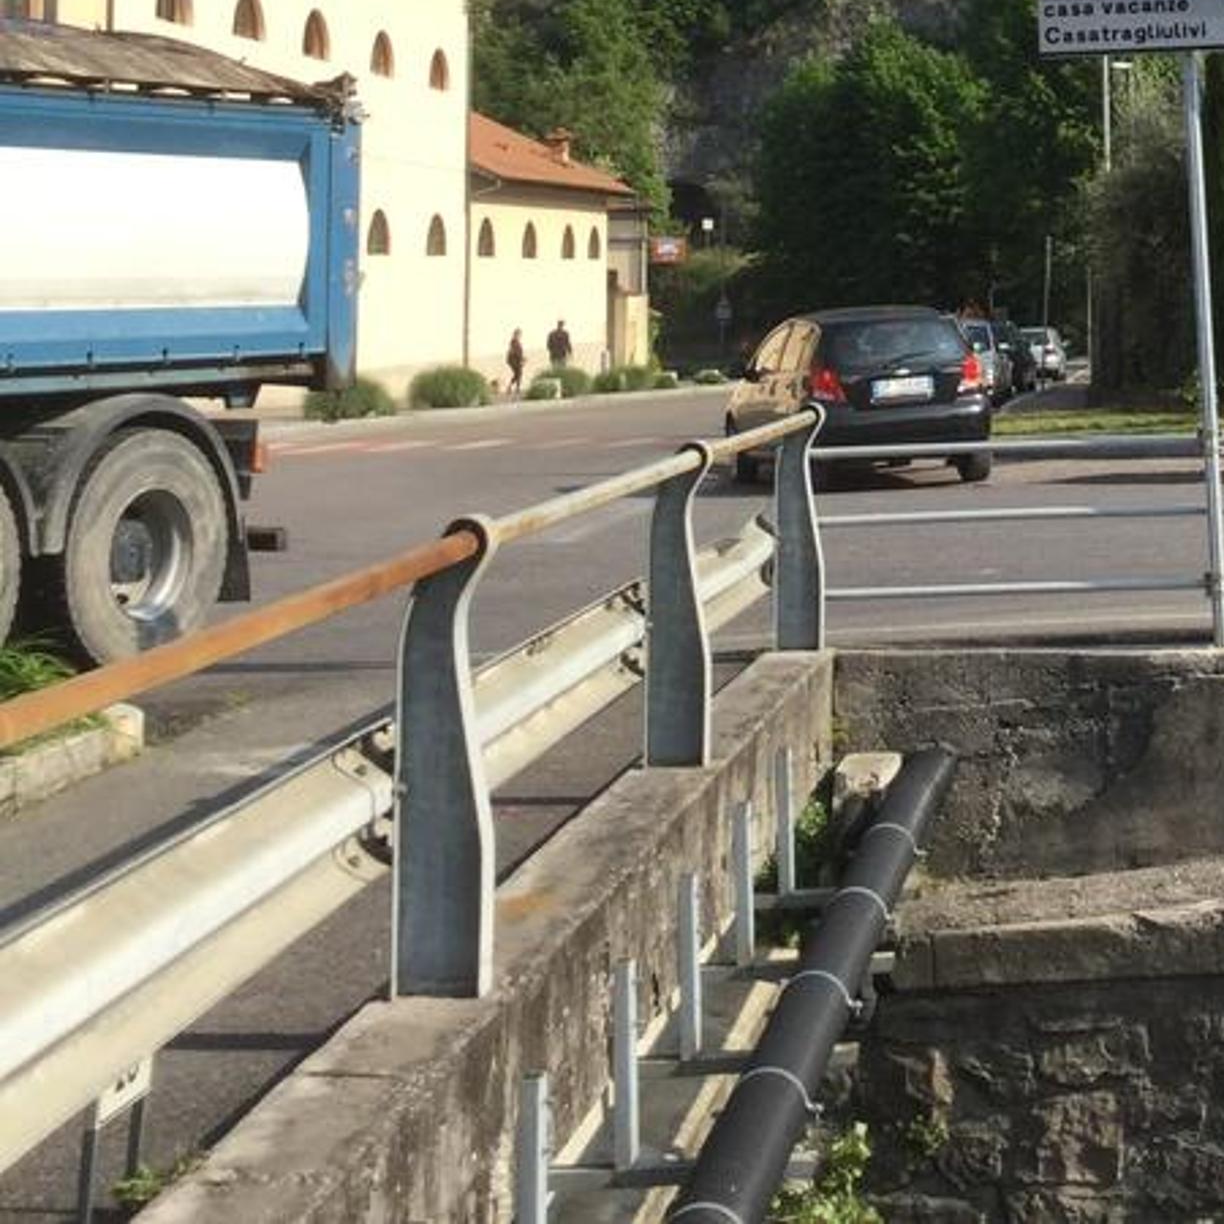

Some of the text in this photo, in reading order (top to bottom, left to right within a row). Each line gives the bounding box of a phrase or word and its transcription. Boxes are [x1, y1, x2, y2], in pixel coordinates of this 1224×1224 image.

[1044, 0, 1190, 17] casa vacanze
[1044, 21, 1207, 44] Casatragliulivi
